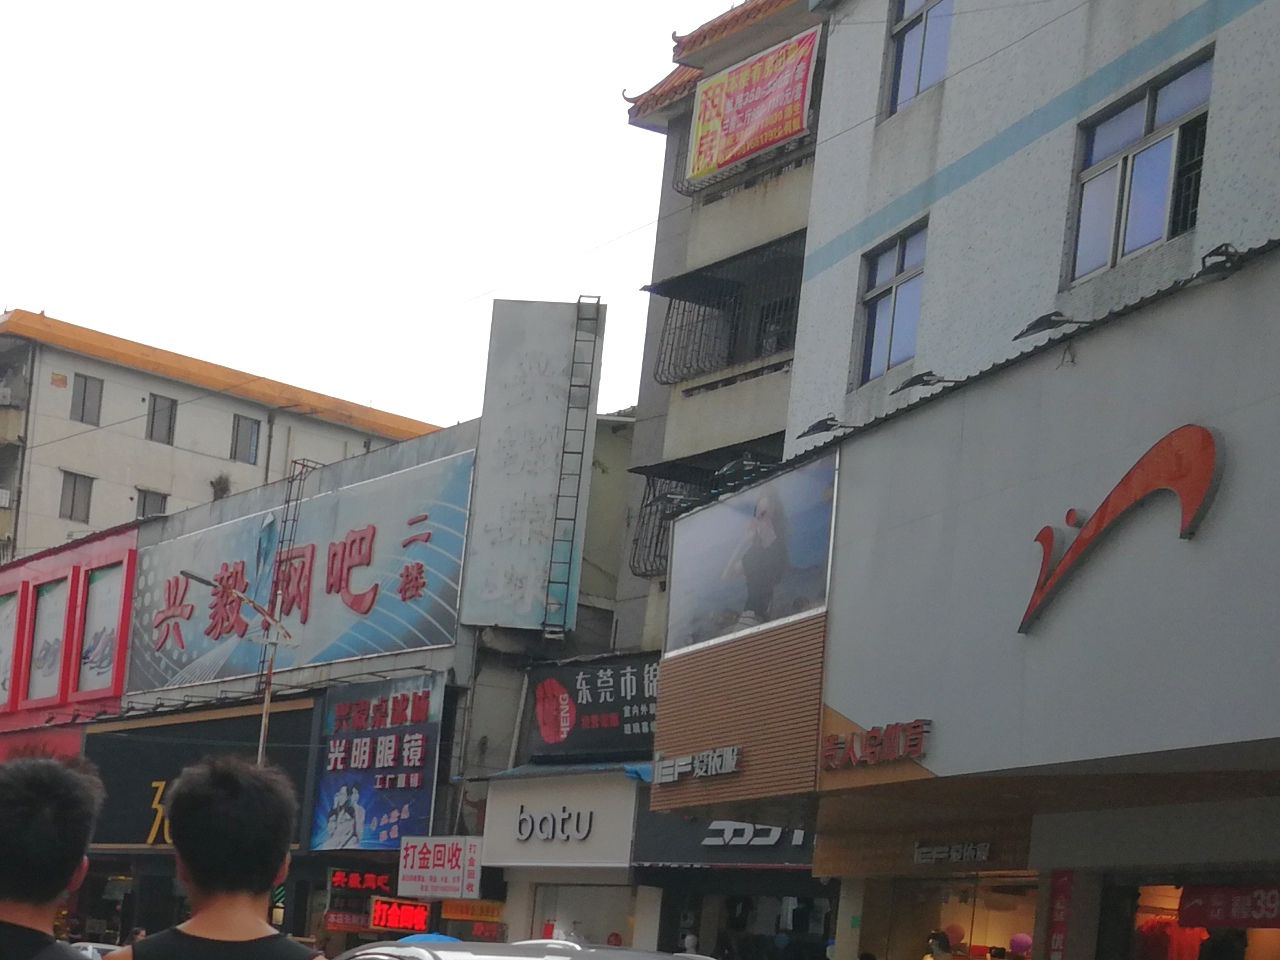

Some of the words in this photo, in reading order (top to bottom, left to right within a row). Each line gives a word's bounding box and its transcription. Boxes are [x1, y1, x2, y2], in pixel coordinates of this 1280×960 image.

[153, 524, 379, 652] 兴毅网吧
[326, 732, 426, 772] 光明眼镜
[517, 805, 592, 842] batu
[404, 842, 463, 871] 打金回收
[465, 844, 478, 894] 打金回收
[373, 900, 428, 932] 打金回收
